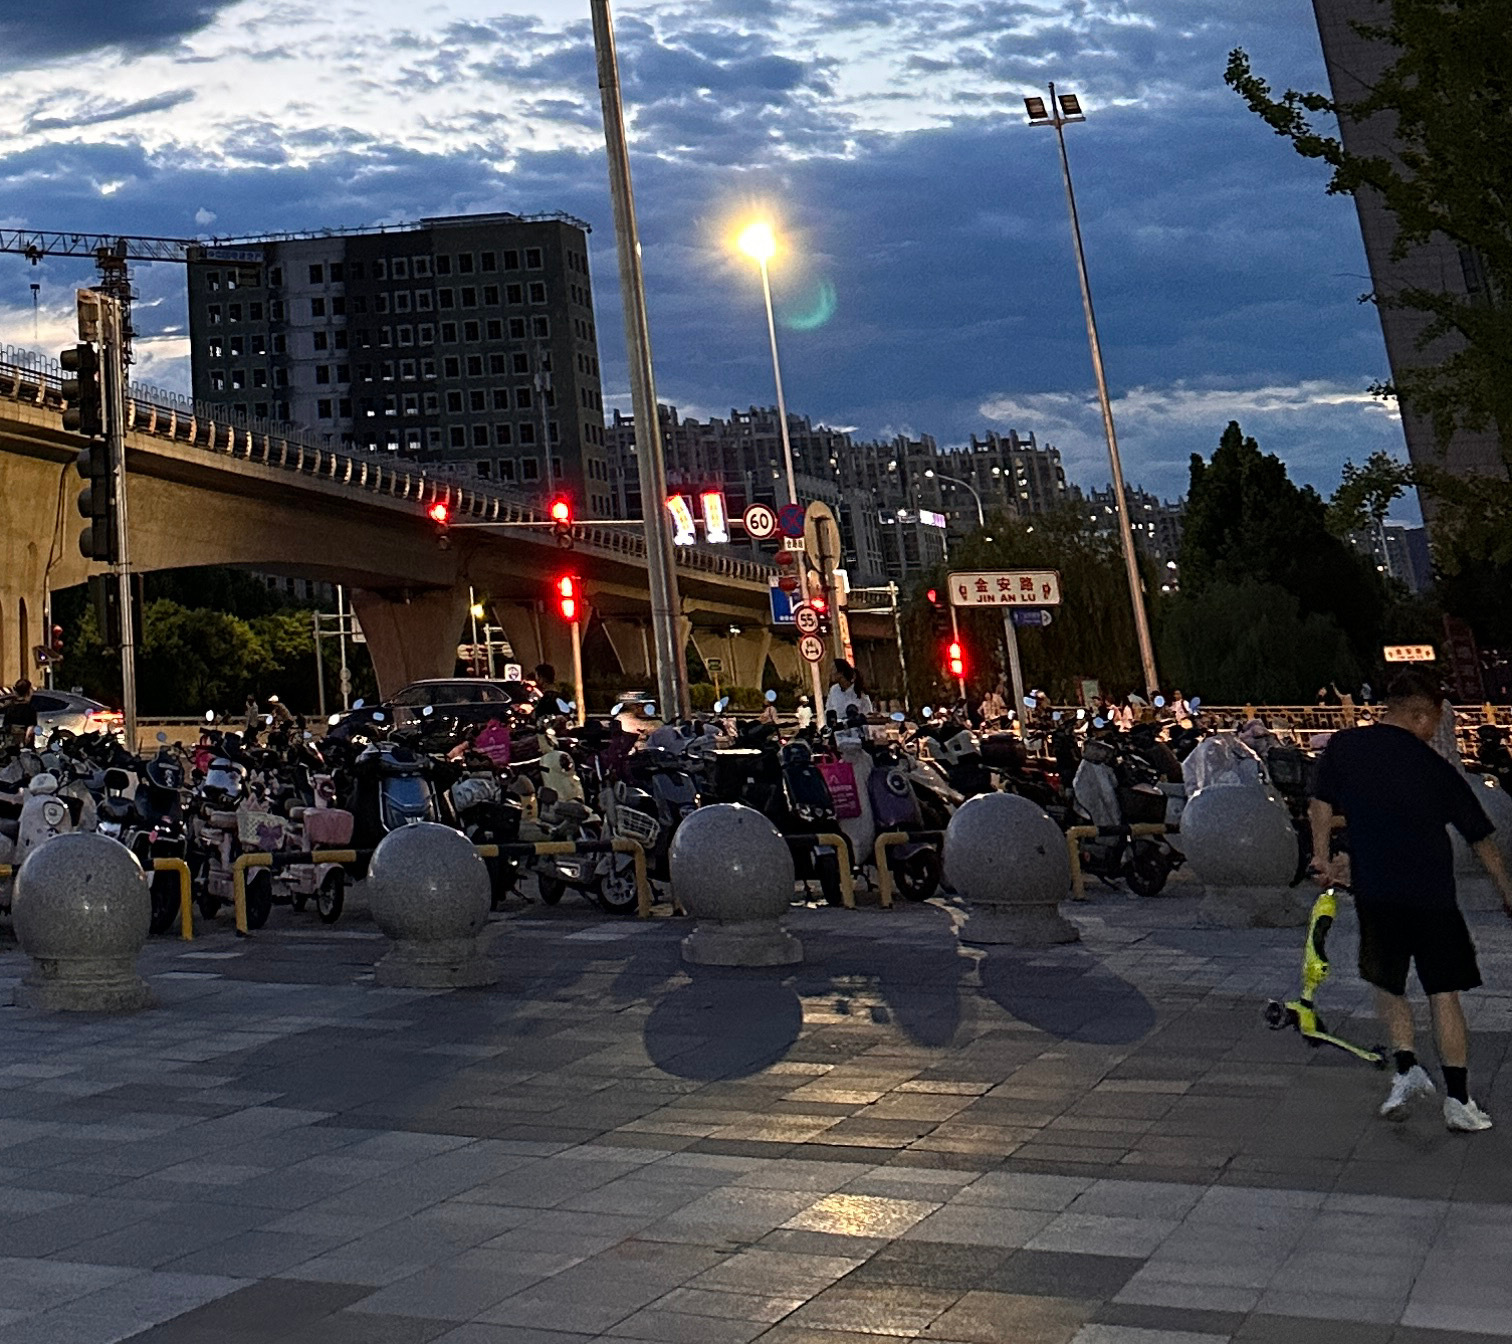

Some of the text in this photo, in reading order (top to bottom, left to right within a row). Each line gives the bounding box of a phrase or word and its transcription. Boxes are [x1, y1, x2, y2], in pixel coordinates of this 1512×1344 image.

[750, 513, 769, 529] 60
[974, 576, 1034, 593] 金安路
[976, 594, 1036, 603] JIN AN LU
